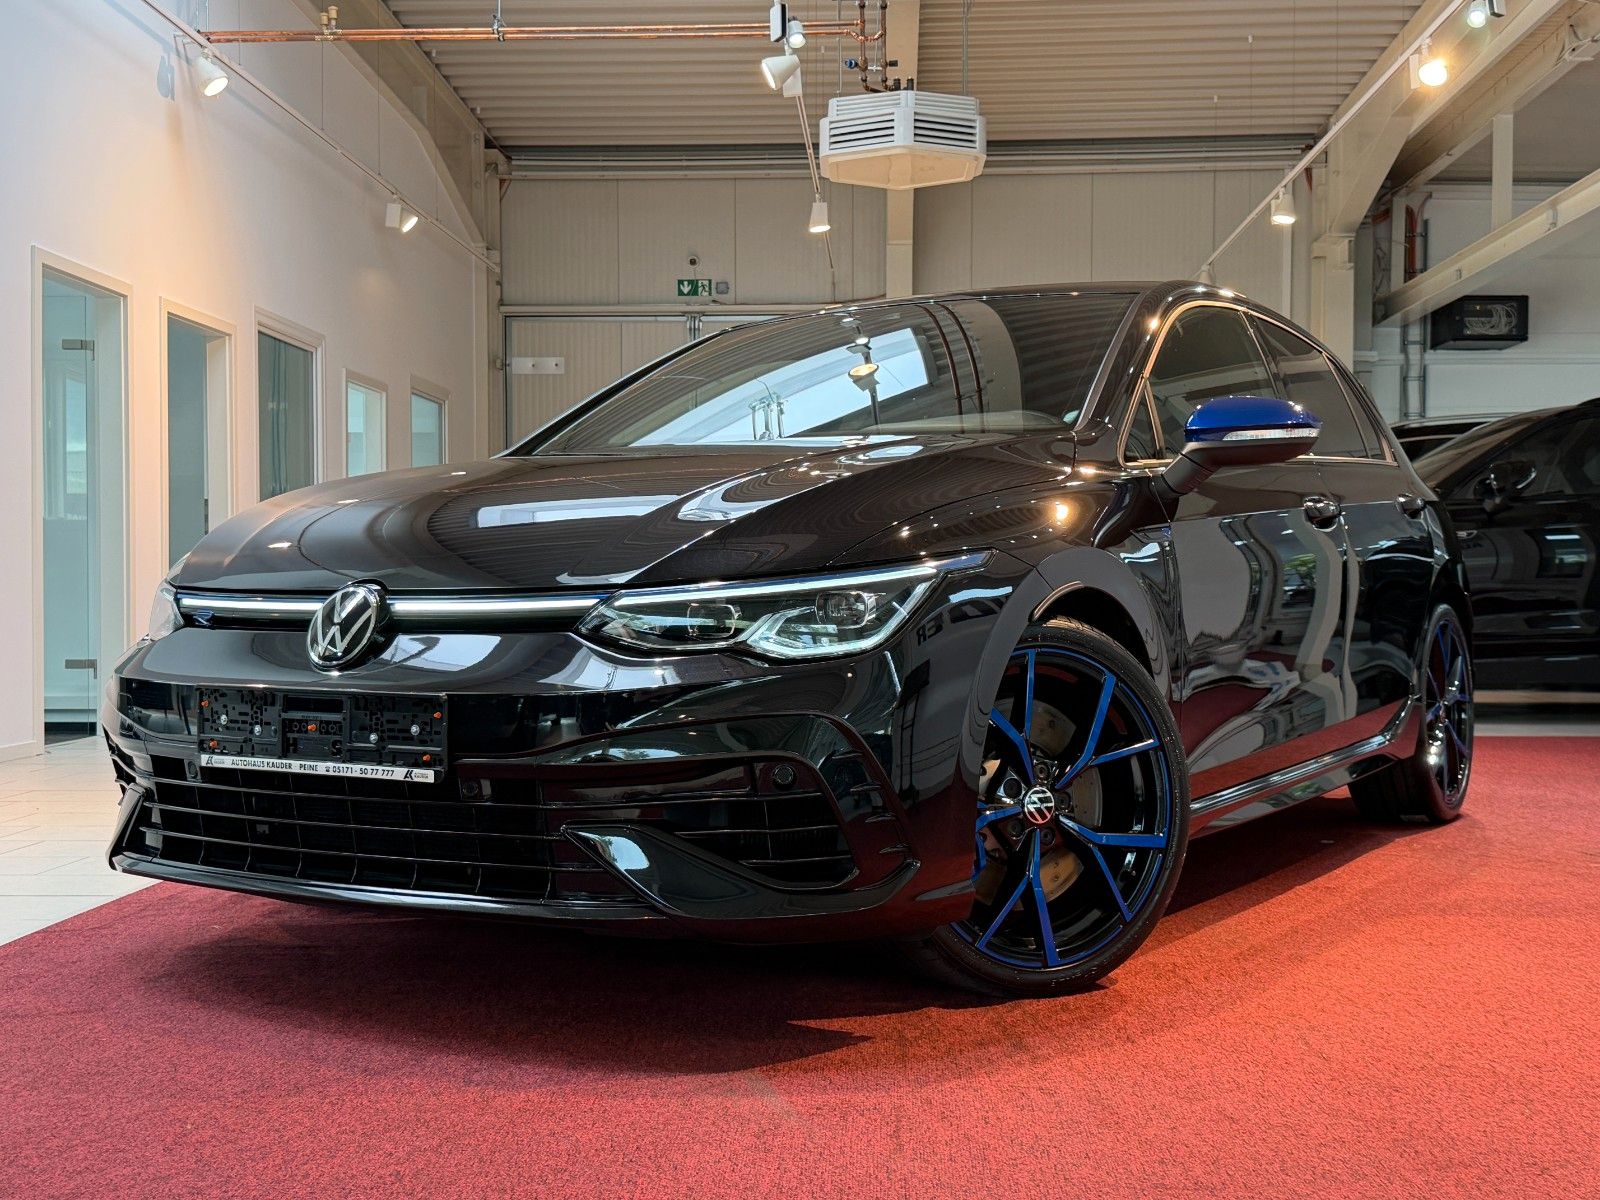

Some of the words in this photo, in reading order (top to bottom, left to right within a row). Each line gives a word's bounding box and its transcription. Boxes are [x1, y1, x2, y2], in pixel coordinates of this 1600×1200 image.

[231, 759, 265, 768] AUTOHAUS
[266, 761, 293, 770] KAUDER
[299, 763, 319, 772] PEINE
[332, 765, 353, 774] 05171
[359, 767, 369, 776] 50
[370, 768, 379, 776] 77
[381, 769, 395, 777] 777
